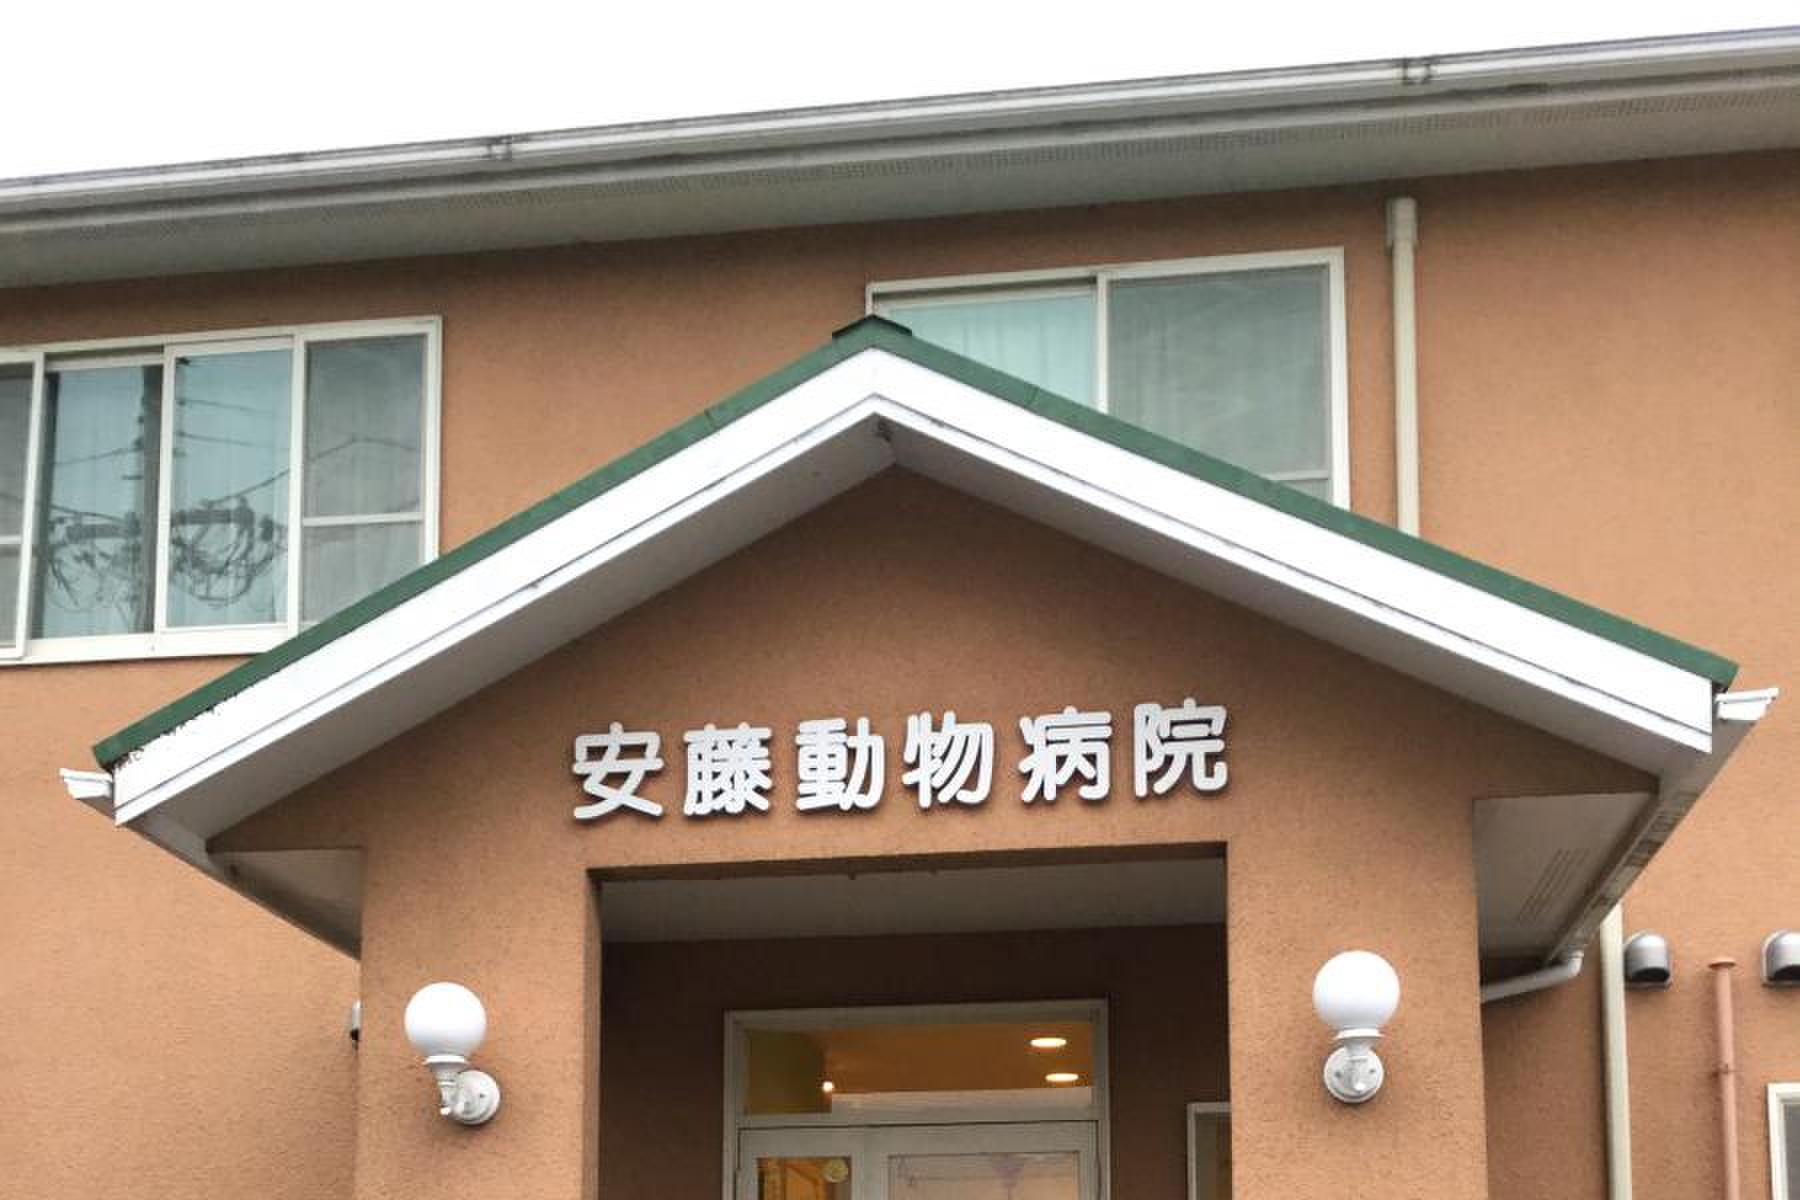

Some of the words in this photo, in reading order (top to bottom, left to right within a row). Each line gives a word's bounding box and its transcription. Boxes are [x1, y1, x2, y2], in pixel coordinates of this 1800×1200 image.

[573, 698, 1229, 819] 安藤動物病院
